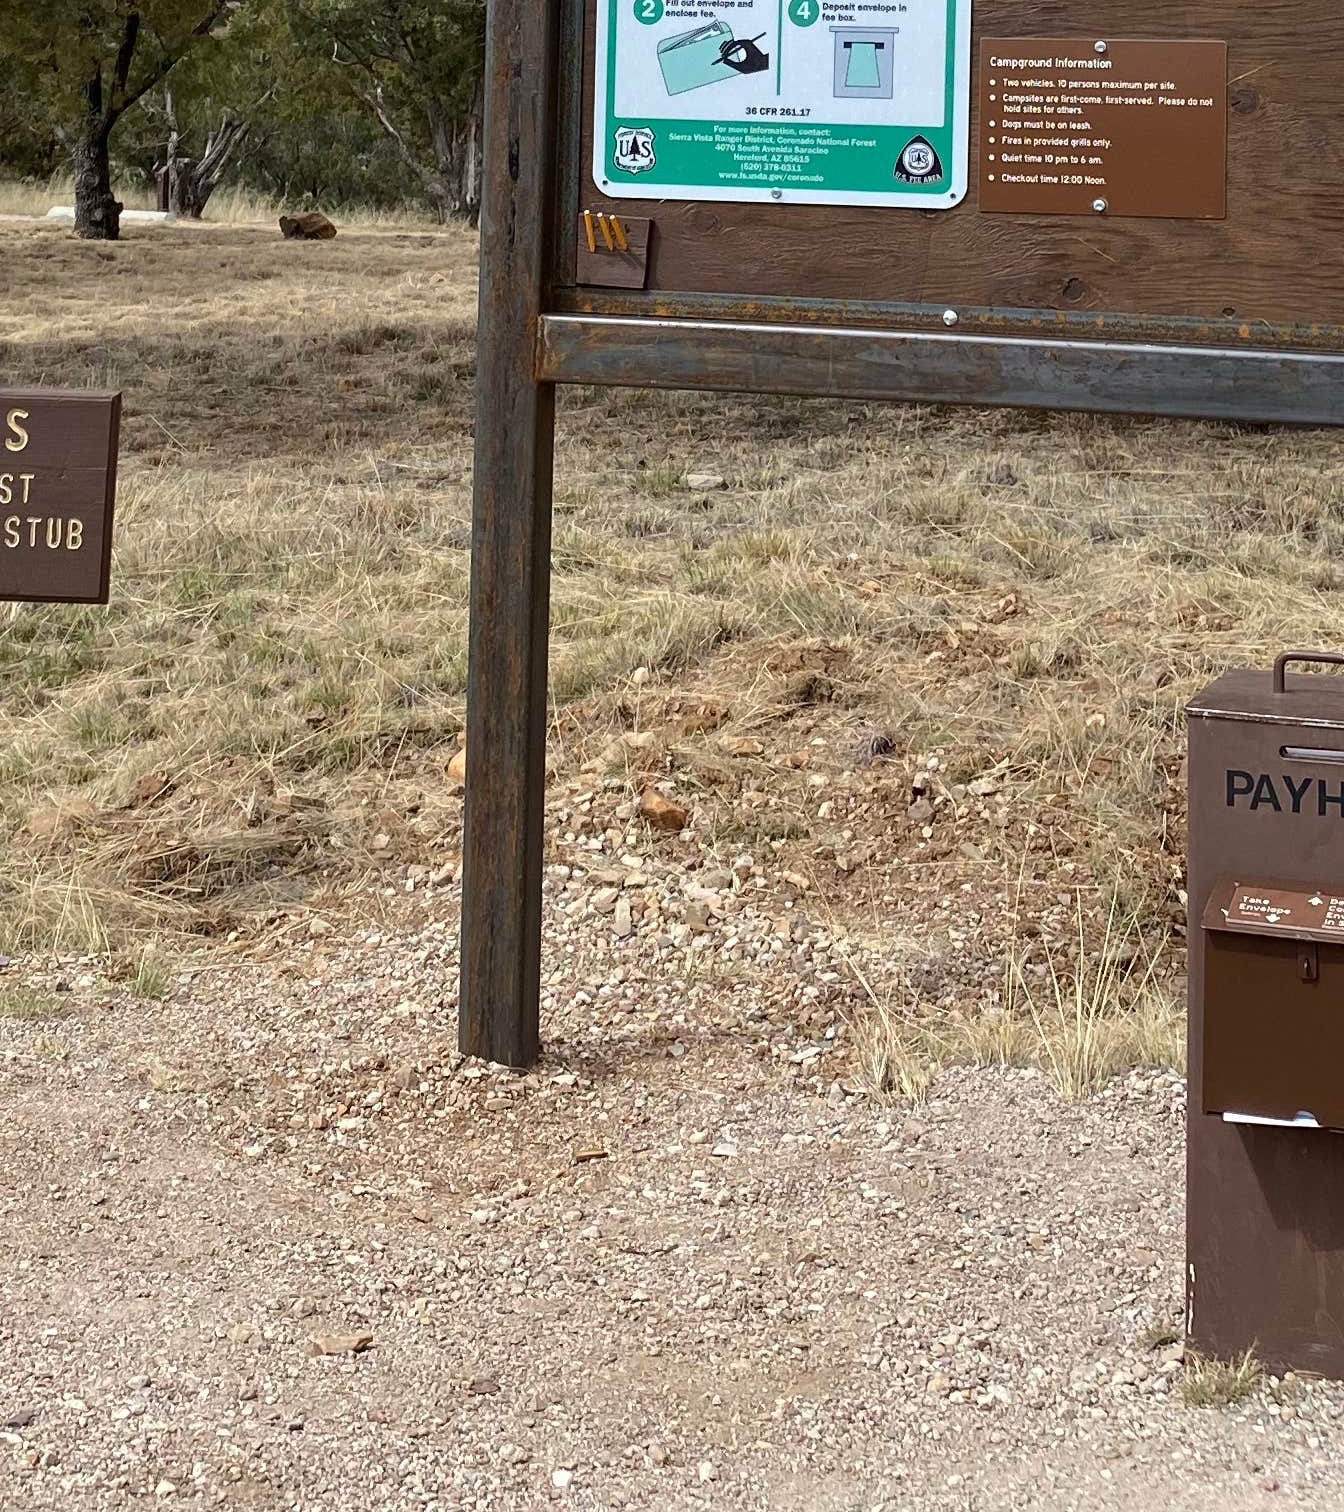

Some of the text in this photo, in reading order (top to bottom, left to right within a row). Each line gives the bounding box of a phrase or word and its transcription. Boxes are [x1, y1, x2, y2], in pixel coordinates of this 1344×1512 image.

[642, 0, 656, 18] 2
[681, 0, 695, 7] out
[697, 0, 736, 9] envelope
[737, 0, 754, 8] and
[796, 1, 811, 20] 4
[822, 2, 907, 13] Deposit envelope in
[665, 9, 716, 18] enclose fee.
[822, 13, 856, 22] fee box.
[990, 56, 1112, 69] Campground Information
[1003, 78, 1019, 87] Two
[1058, 79, 1067, 87] 10
[1068, 80, 1100, 89] persons
[1102, 80, 1142, 89] maximum
[1144, 81, 1158, 90] per
[1160, 81, 1177, 90] site.
[1002, 93, 1044, 103] Campsites
[1045, 95, 1058, 103] are
[1158, 96, 1186, 105] Please
[1199, 98, 1213, 106] not
[745, 107, 811, 117] 36 CFR 261.17
[1003, 104, 1084, 114] hold sites for others.
[1002, 120, 1022, 130] Dogs
[1024, 120, 1044, 128] must
[1045, 120, 1055, 129] be
[1069, 121, 1092, 130] leash.
[668, 133, 692, 142] Sierra
[693, 133, 714, 142] Vista
[714, 135, 743, 144] Ranger
[816, 138, 850, 147] National
[851, 138, 877, 147] Forest
[1002, 135, 1112, 149] Fires in provided grills only.
[1001, 153, 1022, 162] Quiet
[1024, 154, 1042, 163] time
[1045, 154, 1053, 163] 10
[1055, 156, 1068, 165] pm
[1070, 155, 1078, 163] to
[1080, 156, 1086, 164] 6
[1001, 174, 1107, 185] Checkout time 12:00 Noon.
[4, 517, 84, 551] STUB
[1226, 769, 1312, 814] PAY
[1242, 895, 1270, 905] Take
[1239, 903, 1291, 915] Envelope
